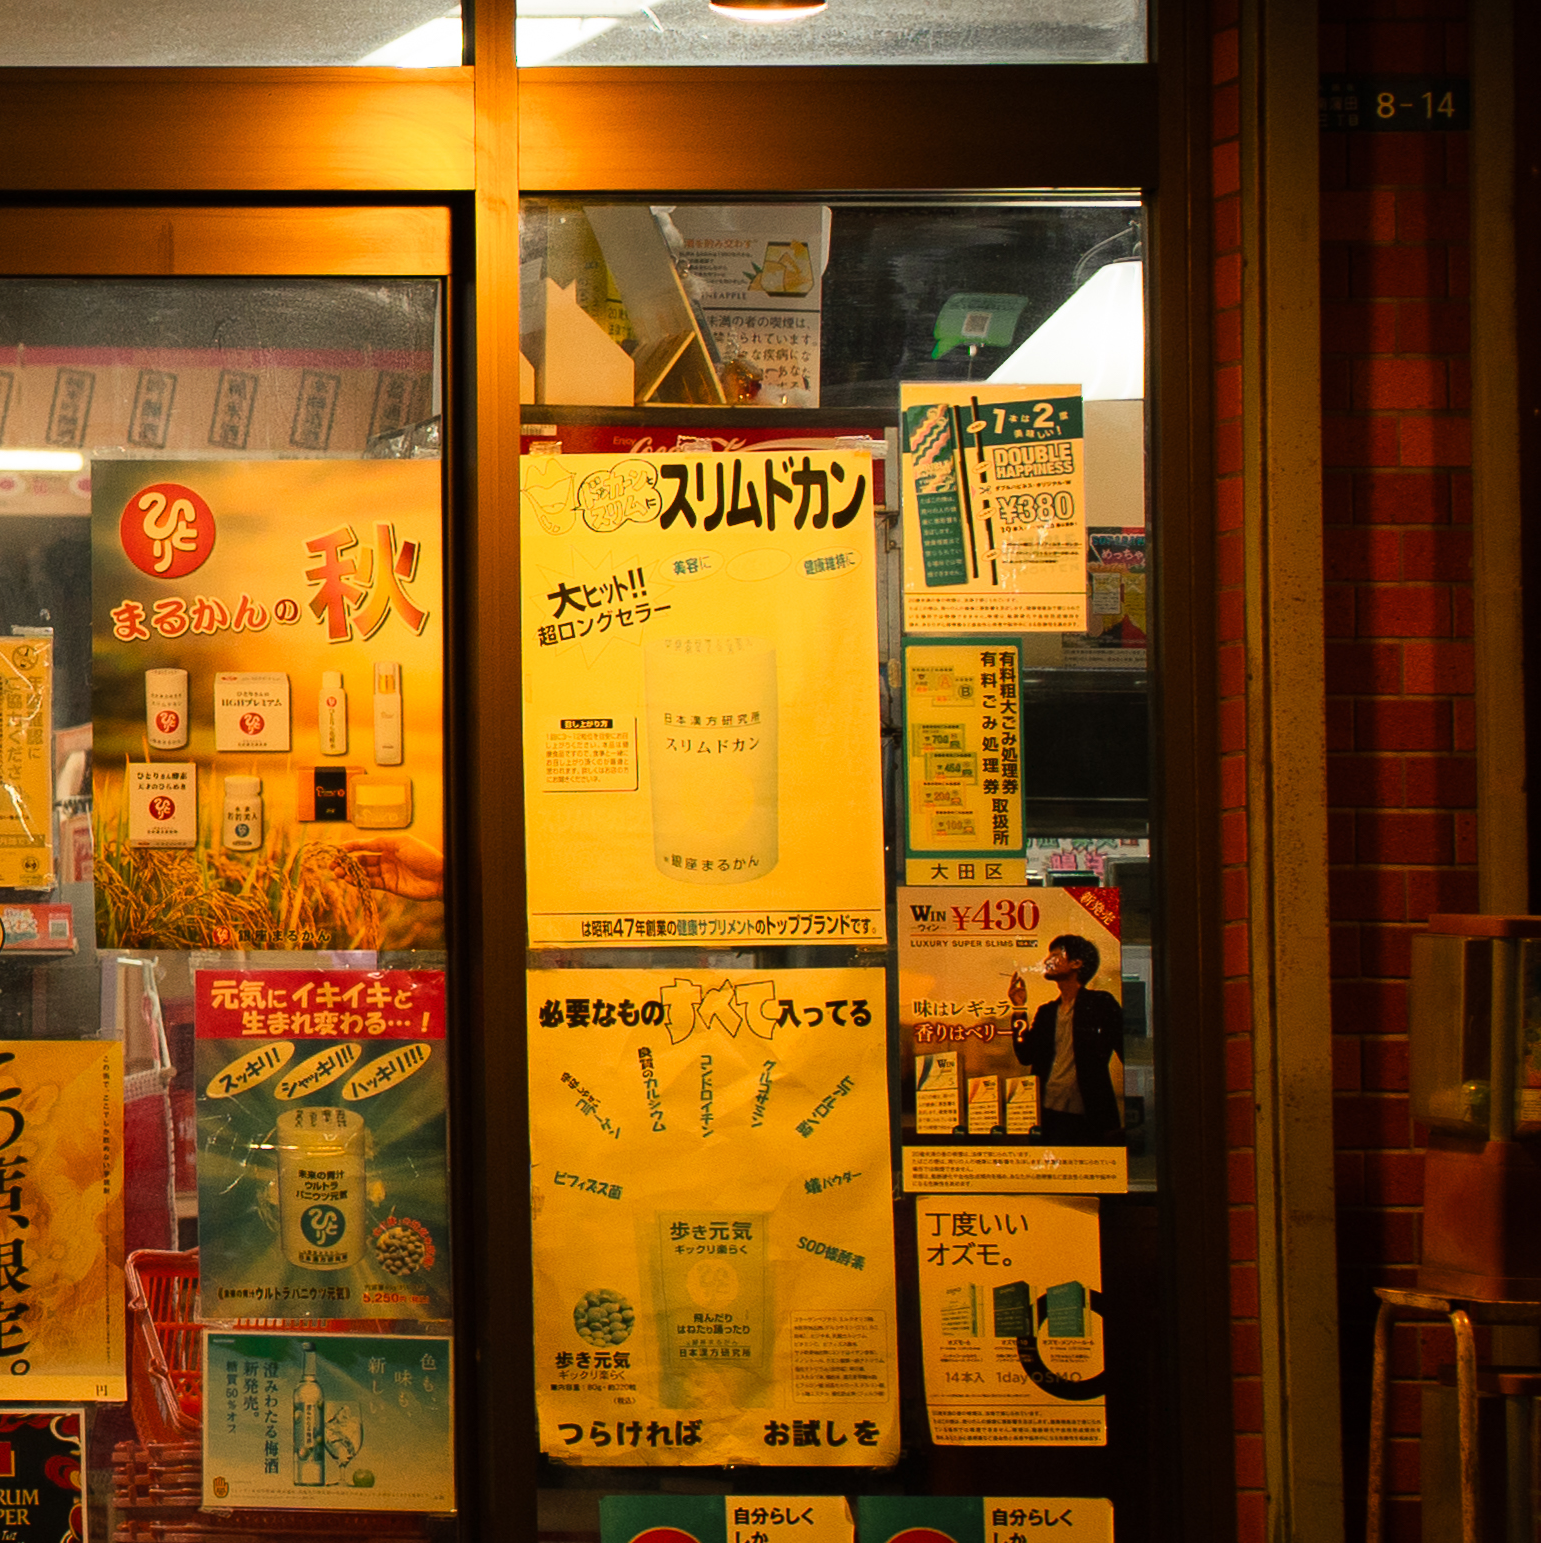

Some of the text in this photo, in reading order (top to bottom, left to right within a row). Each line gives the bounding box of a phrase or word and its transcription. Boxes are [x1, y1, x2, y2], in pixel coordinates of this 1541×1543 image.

[1377, 92, 1455, 118] 8-14
[993, 443, 1072, 466] DOUBLE
[997, 461, 1074, 480] HAPPINESS
[659, 458, 865, 531] スリムドカン
[997, 492, 1074, 524] ¥380
[673, 556, 711, 574] 美容に
[804, 552, 854, 575] 健康維持に
[547, 568, 647, 619] 大ヒット!!
[538, 603, 671, 646] 超ロングセラー
[665, 712, 760, 725] 日本漢方研究所
[980, 652, 999, 794] 有料ごみ処理券
[999, 652, 1018, 794] 有料粗大ごみ処理券
[666, 737, 759, 753] スリムドカン
[992, 798, 1009, 845] 取扱所
[671, 854, 759, 873] 銀座まるかん
[931, 863, 1002, 879] 大田区
[951, 899, 1040, 930] ¥430
[238, 929, 330, 942] 銀座まるかん
[211, 981, 413, 1010] 元気にイキイキと
[913, 1000, 1028, 1018] 味はレギュラー
[700, 1055, 714, 1138] コンドロイチン
[751, 1059, 776, 1129] グルコサミン
[305, 1181, 338, 1190] ウルトラ
[554, 1171, 623, 1199] ビフィズス菌
[670, 1221, 753, 1241] 歩き元気
[925, 1212, 1029, 1236] 丁度いい
[675, 1245, 748, 1254] ギックリ楽らく
[797, 1237, 865, 1271] SOD様酵素
[927, 1242, 1011, 1266] オズモ。
[694, 1313, 732, 1323] 飛んだり
[555, 1351, 631, 1369] 歩き元気
[559, 1370, 625, 1380] ギックリ楽らく
[945, 1371, 1082, 1384] 14本入 1day OSMO
[243, 1362, 259, 1417] 新発売。
[264, 1362, 278, 1474] 澄みわたる梅酒
[558, 1420, 879, 1447] つらければ お試しを
[734, 1507, 815, 1526] 自分らしく
[992, 1508, 1074, 1527] 自分らしく
